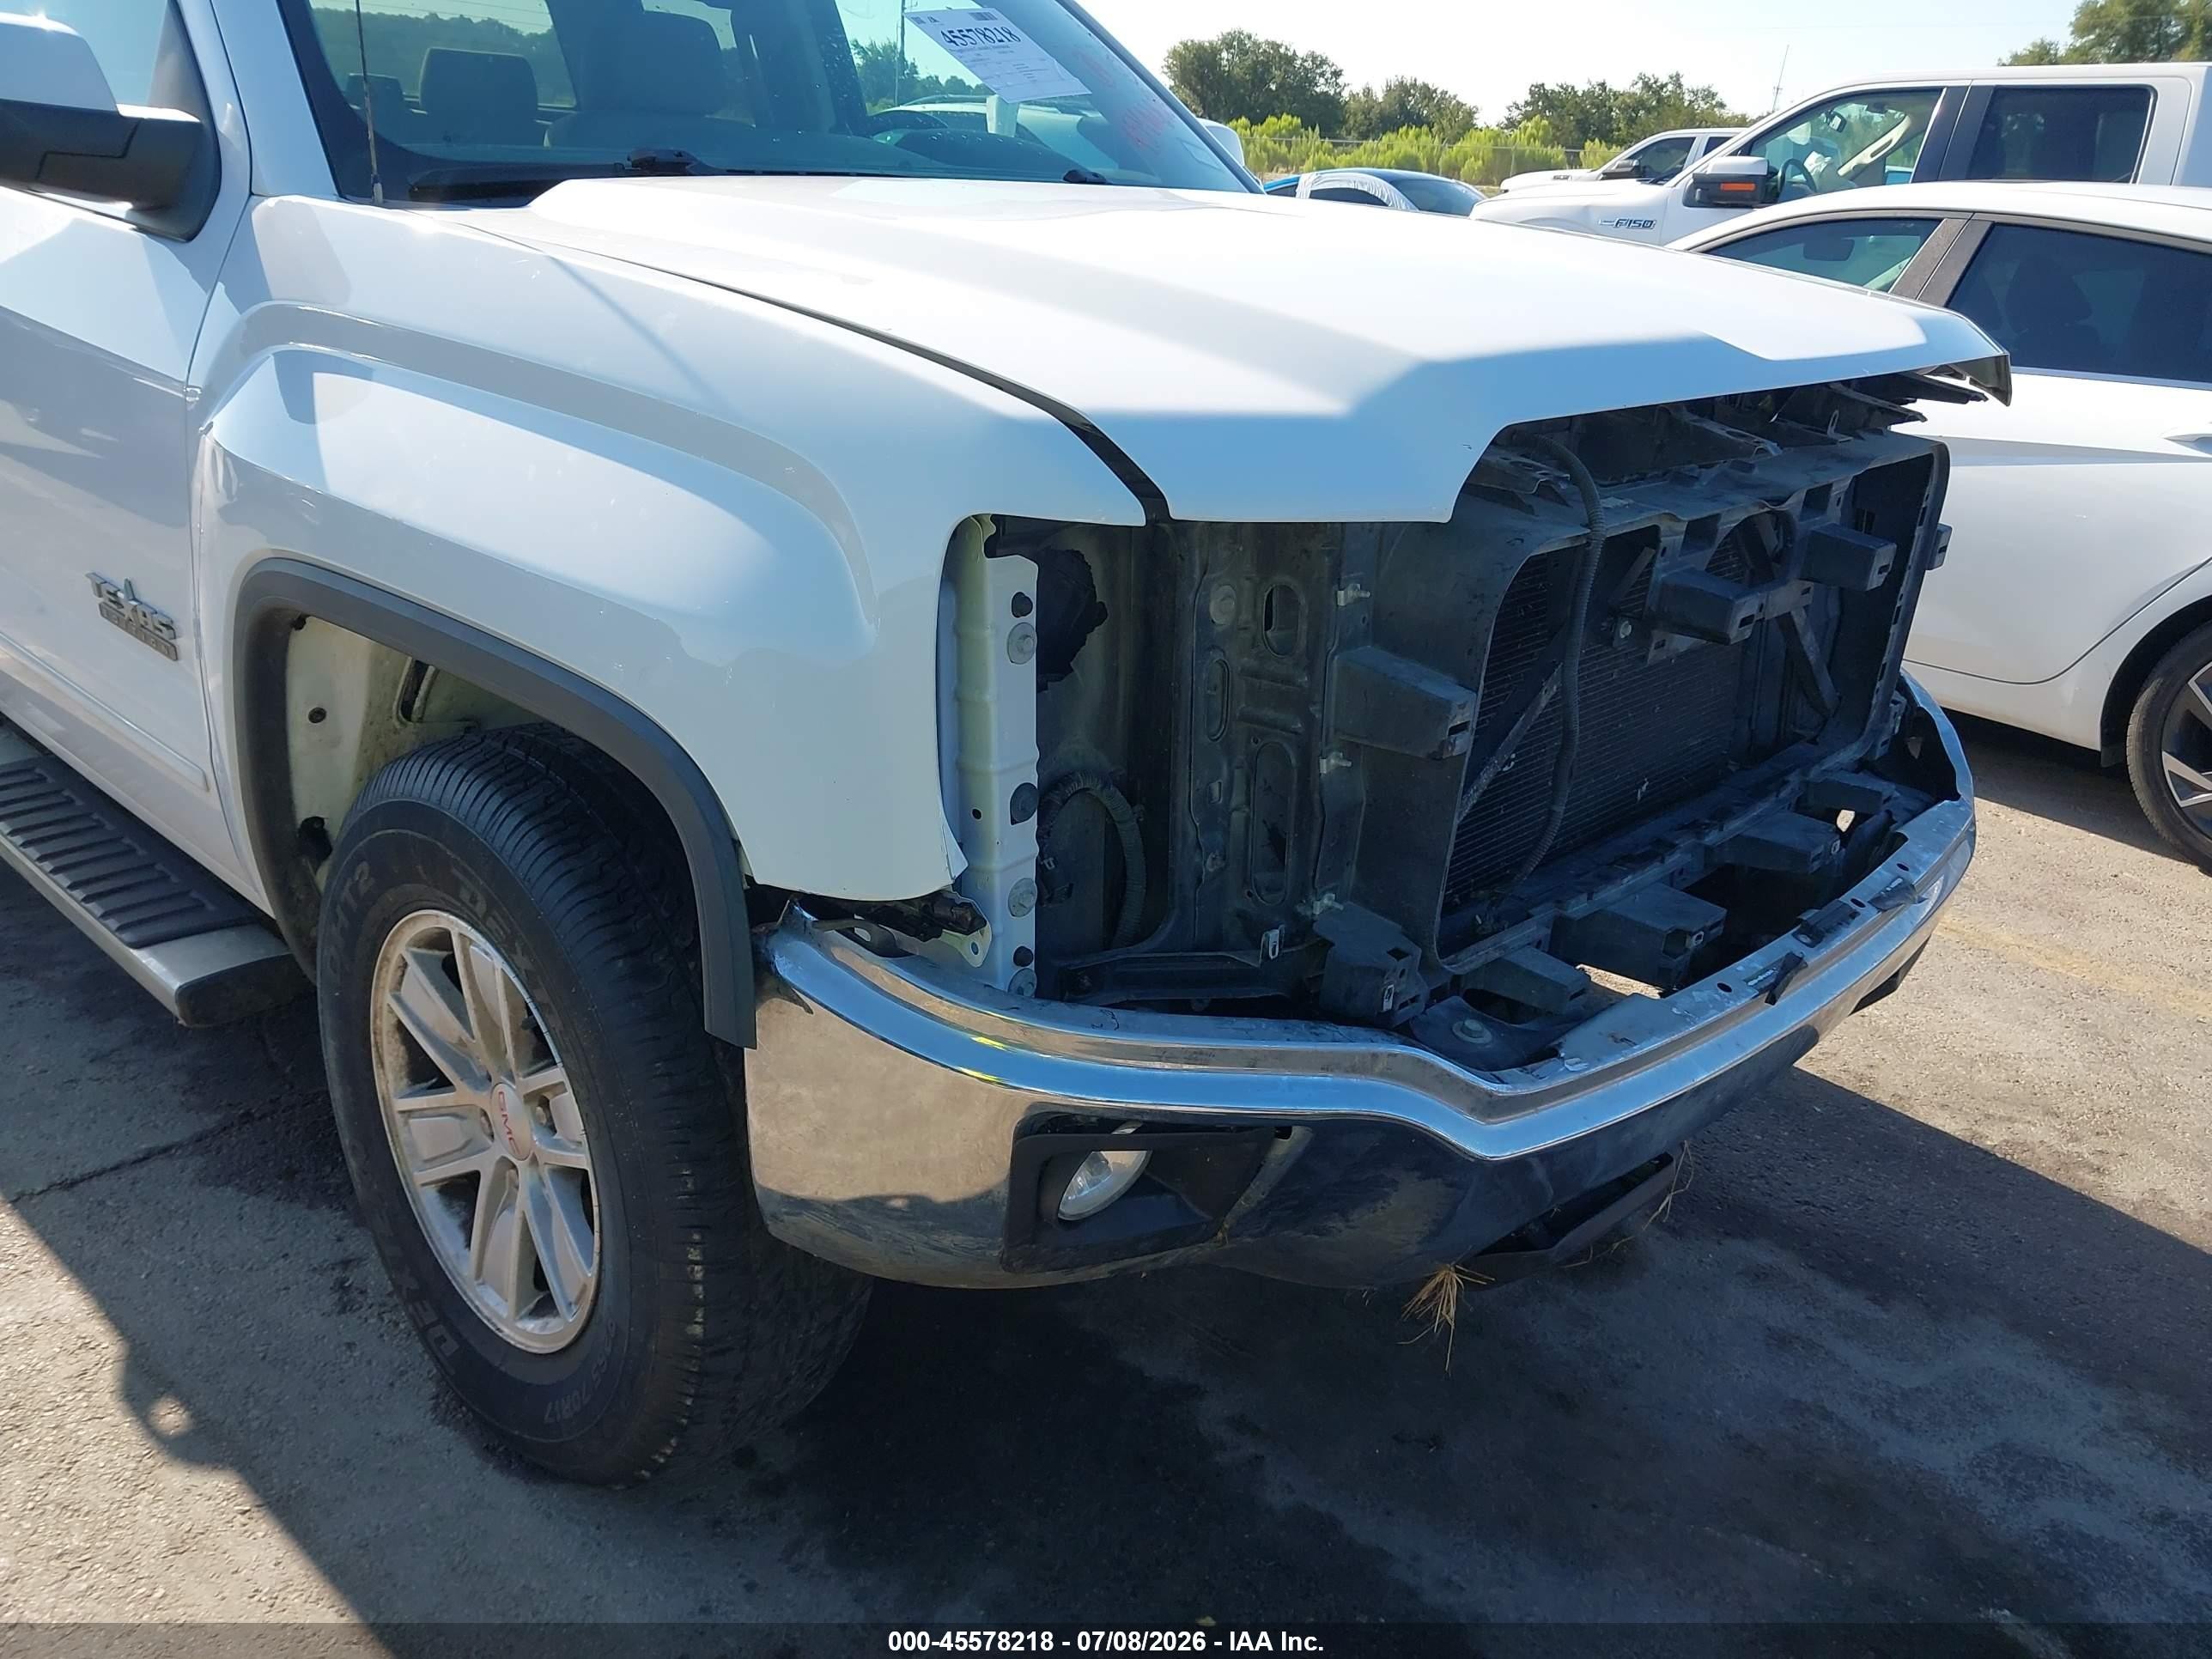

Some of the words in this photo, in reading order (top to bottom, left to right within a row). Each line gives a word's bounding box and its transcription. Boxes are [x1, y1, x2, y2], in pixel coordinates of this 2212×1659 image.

[940, 27, 1021, 46] 45578218
[85, 572, 176, 640] TEXAS
[498, 1091, 522, 1155] GMC
